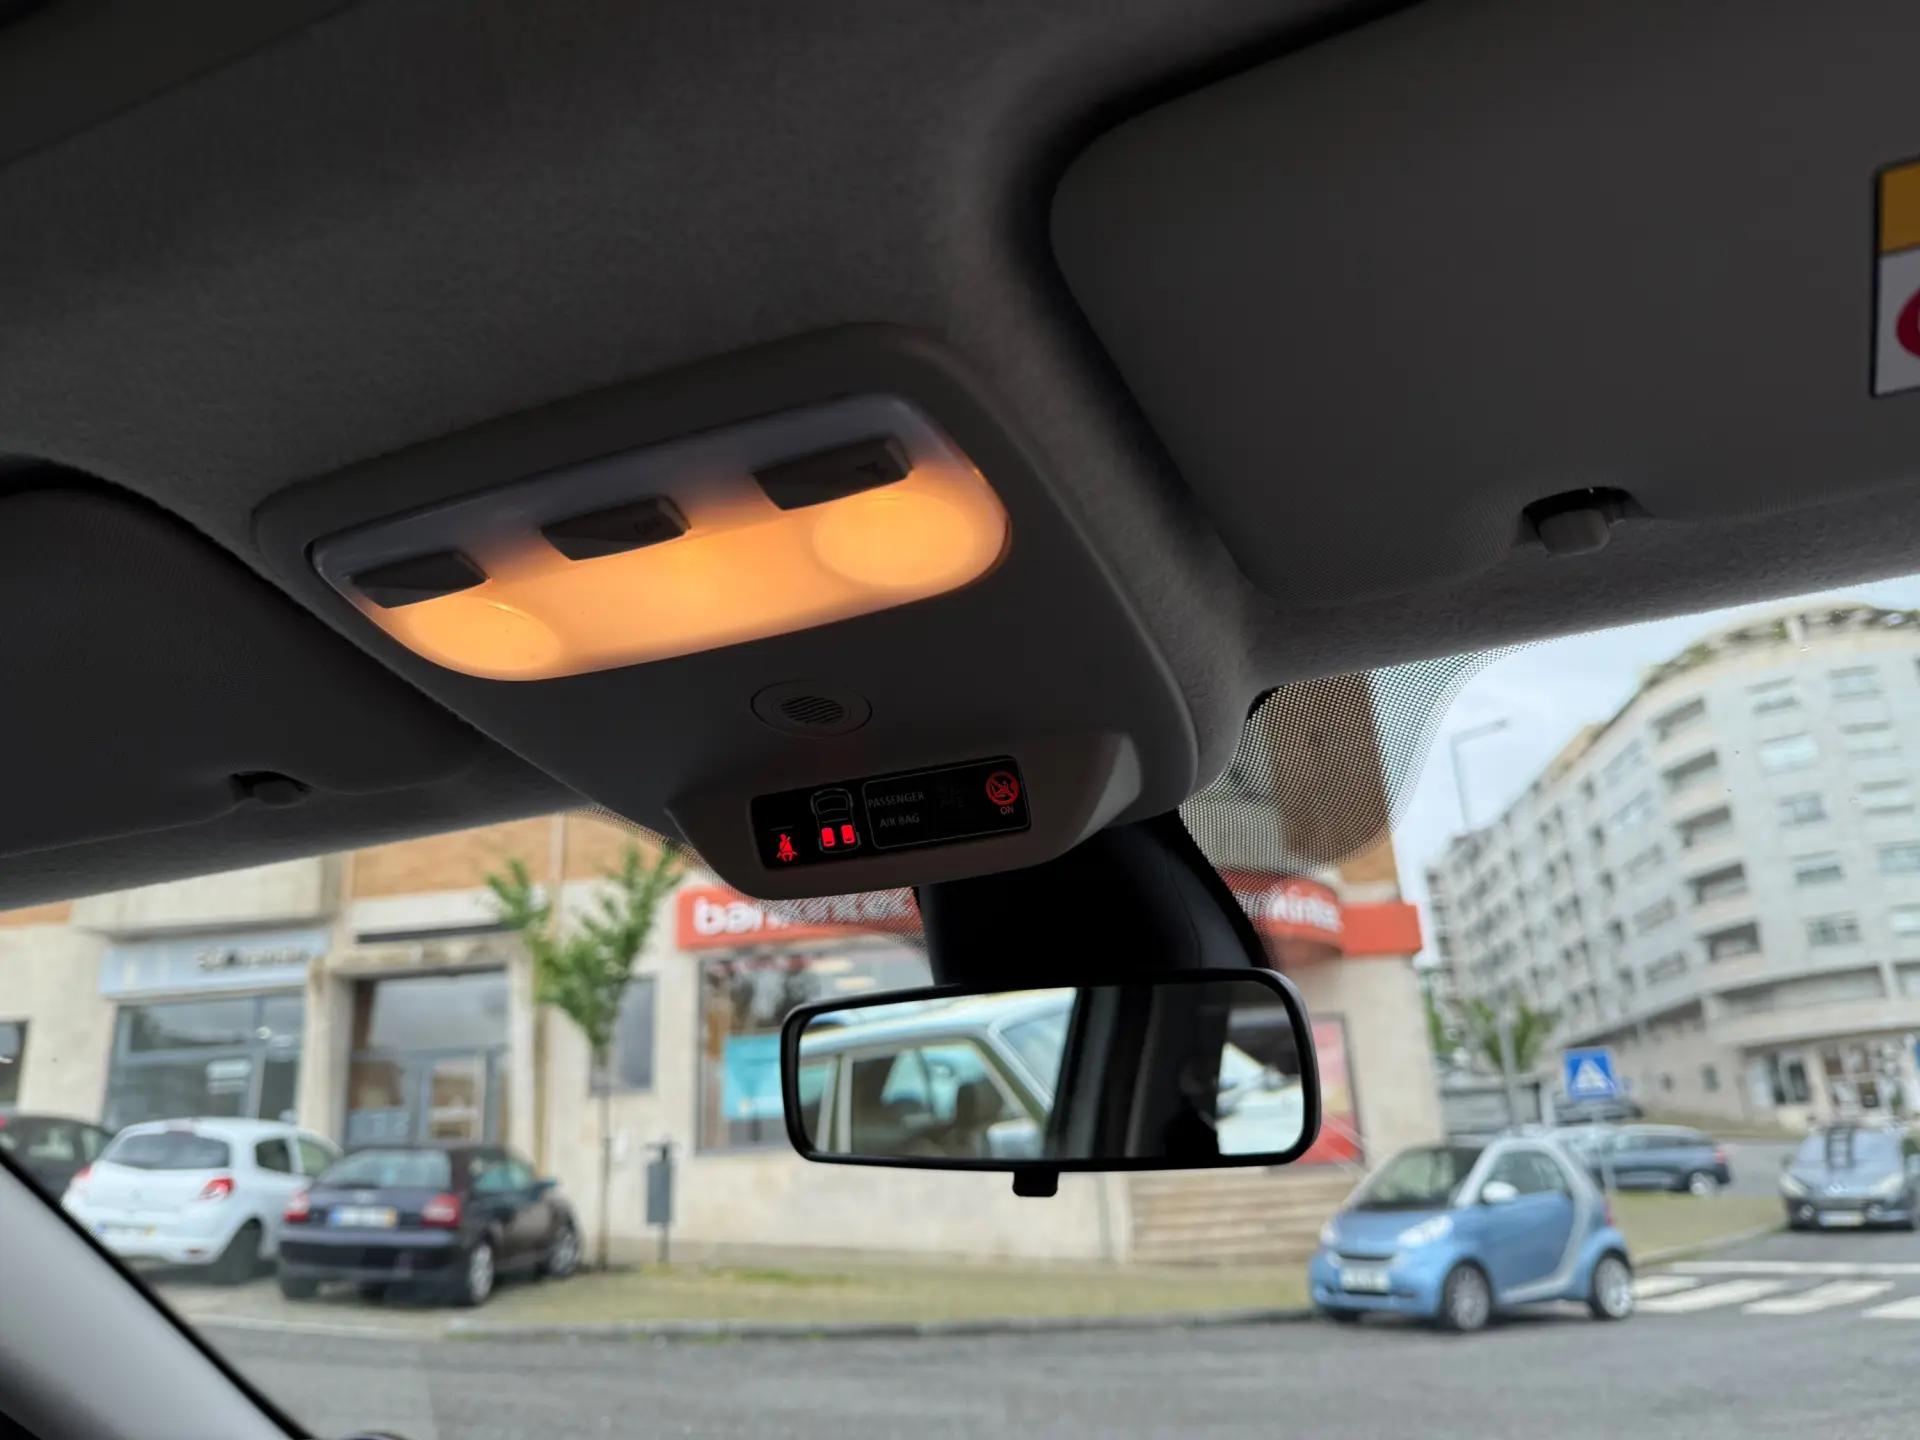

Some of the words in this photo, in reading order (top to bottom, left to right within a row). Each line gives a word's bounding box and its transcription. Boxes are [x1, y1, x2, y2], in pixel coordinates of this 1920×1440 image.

[869, 791, 925, 808] PASSENGER
[1000, 805, 1014, 815] ON
[879, 816, 897, 828] AIR
[899, 813, 920, 826] BAG
